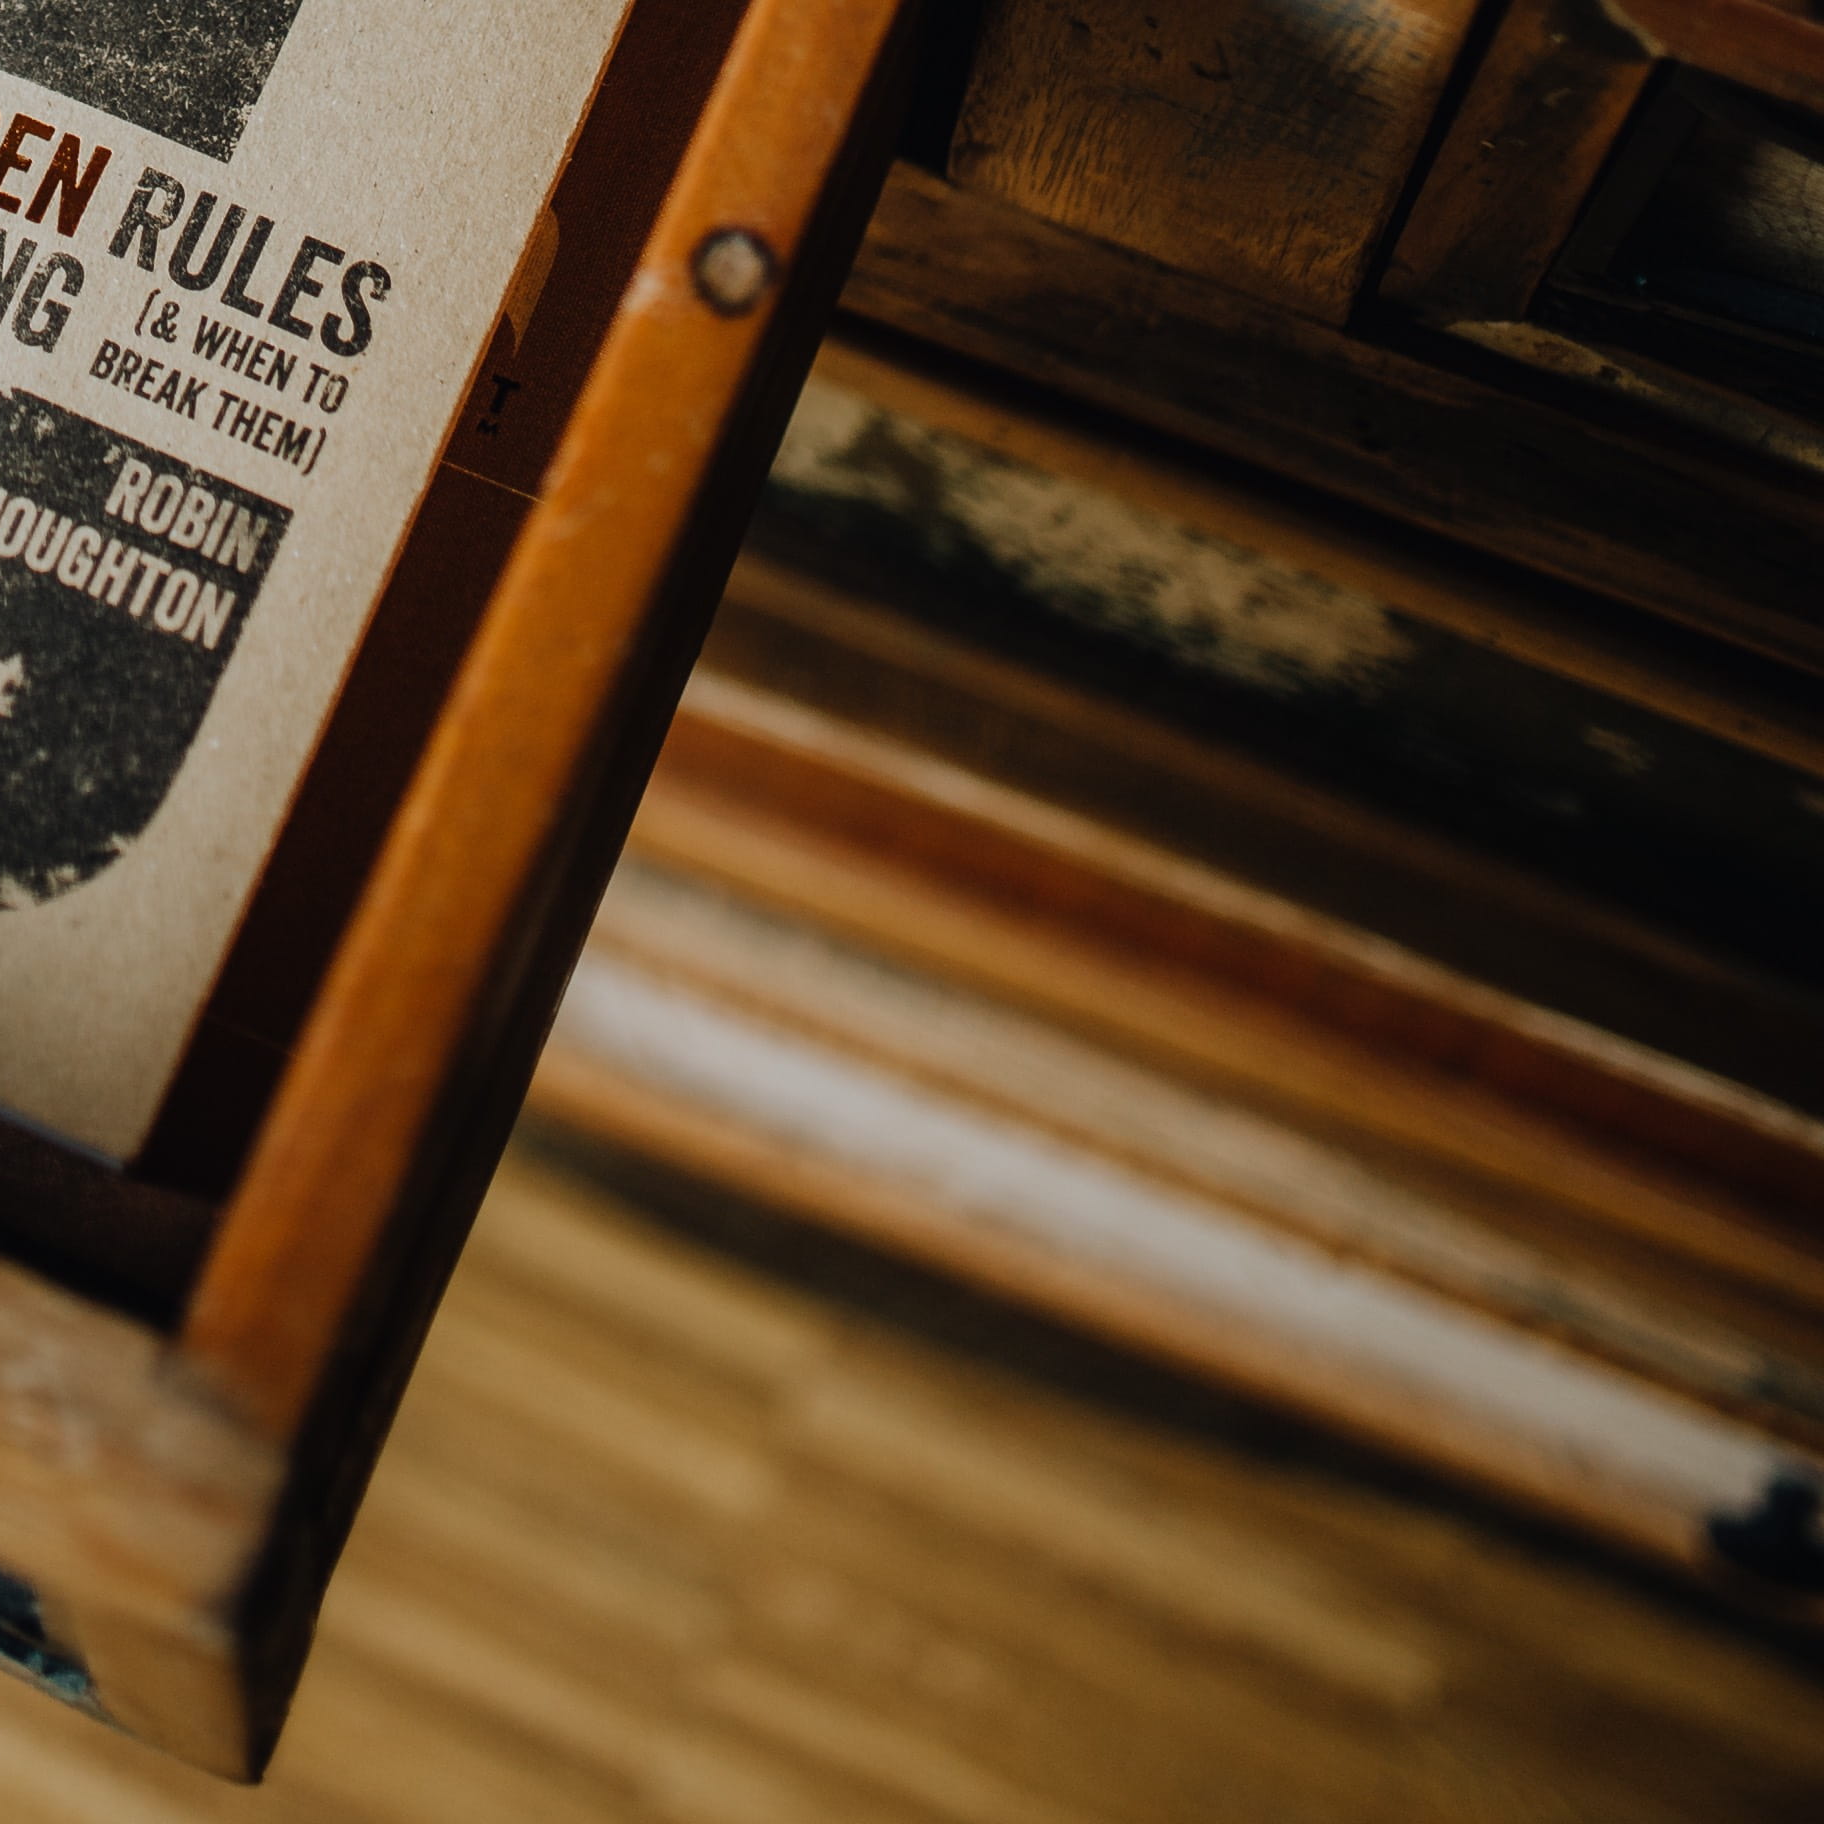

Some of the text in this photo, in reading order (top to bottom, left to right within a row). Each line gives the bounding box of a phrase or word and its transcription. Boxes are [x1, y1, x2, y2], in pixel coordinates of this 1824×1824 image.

[108, 166, 392, 357] RULES
[89, 340, 328, 476] BREAK THEM)
[134, 288, 351, 414] (& WHEN TO
[104, 461, 268, 574] ROBIN
